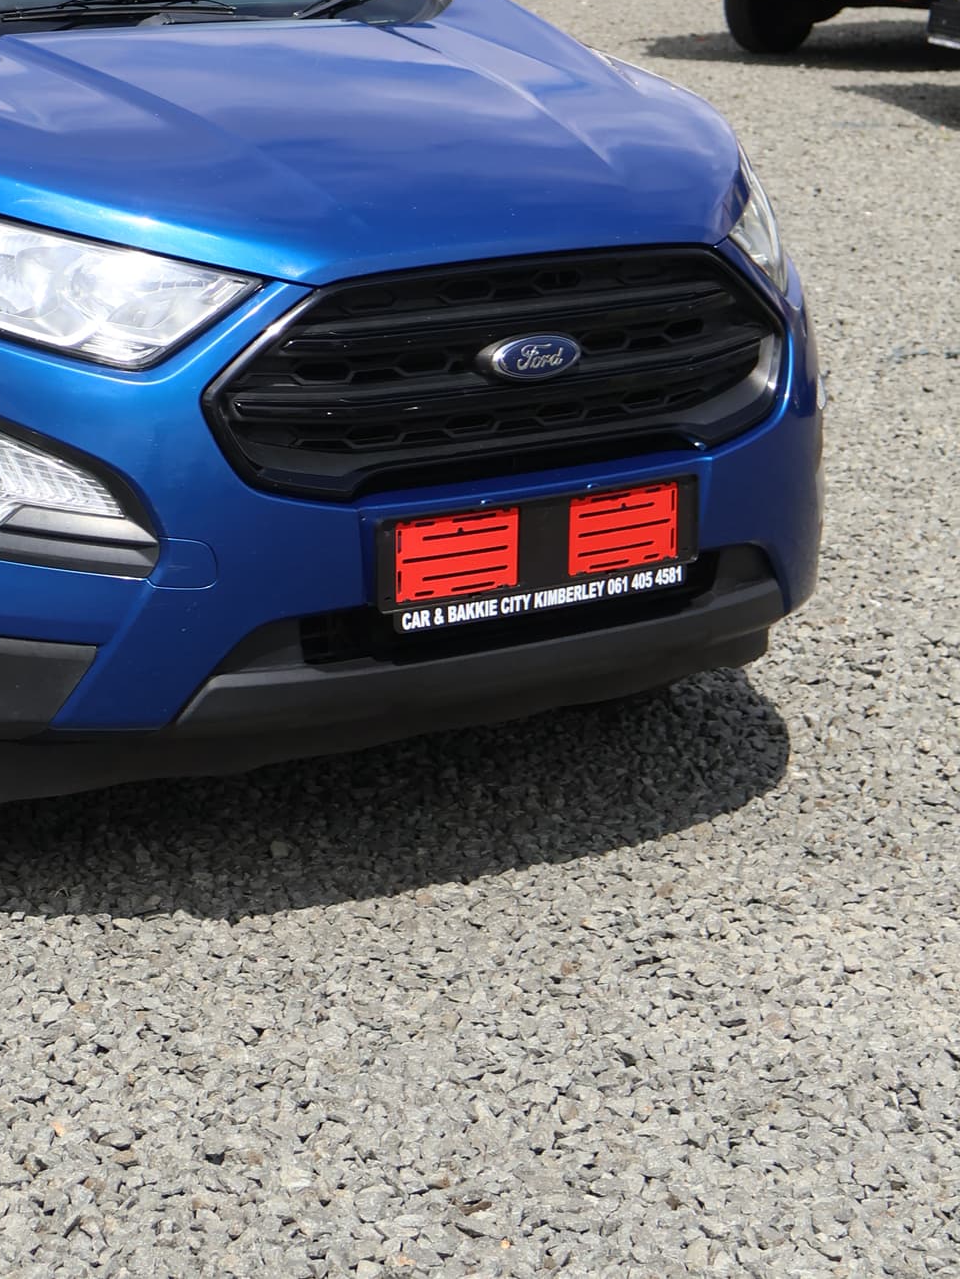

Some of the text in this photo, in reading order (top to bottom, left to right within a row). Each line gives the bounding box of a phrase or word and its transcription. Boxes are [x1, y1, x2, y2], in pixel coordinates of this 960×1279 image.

[517, 343, 564, 371] Ford
[401, 564, 683, 631] CAR & BAKKIE CITY KIMBERLEY 061 405 4581
